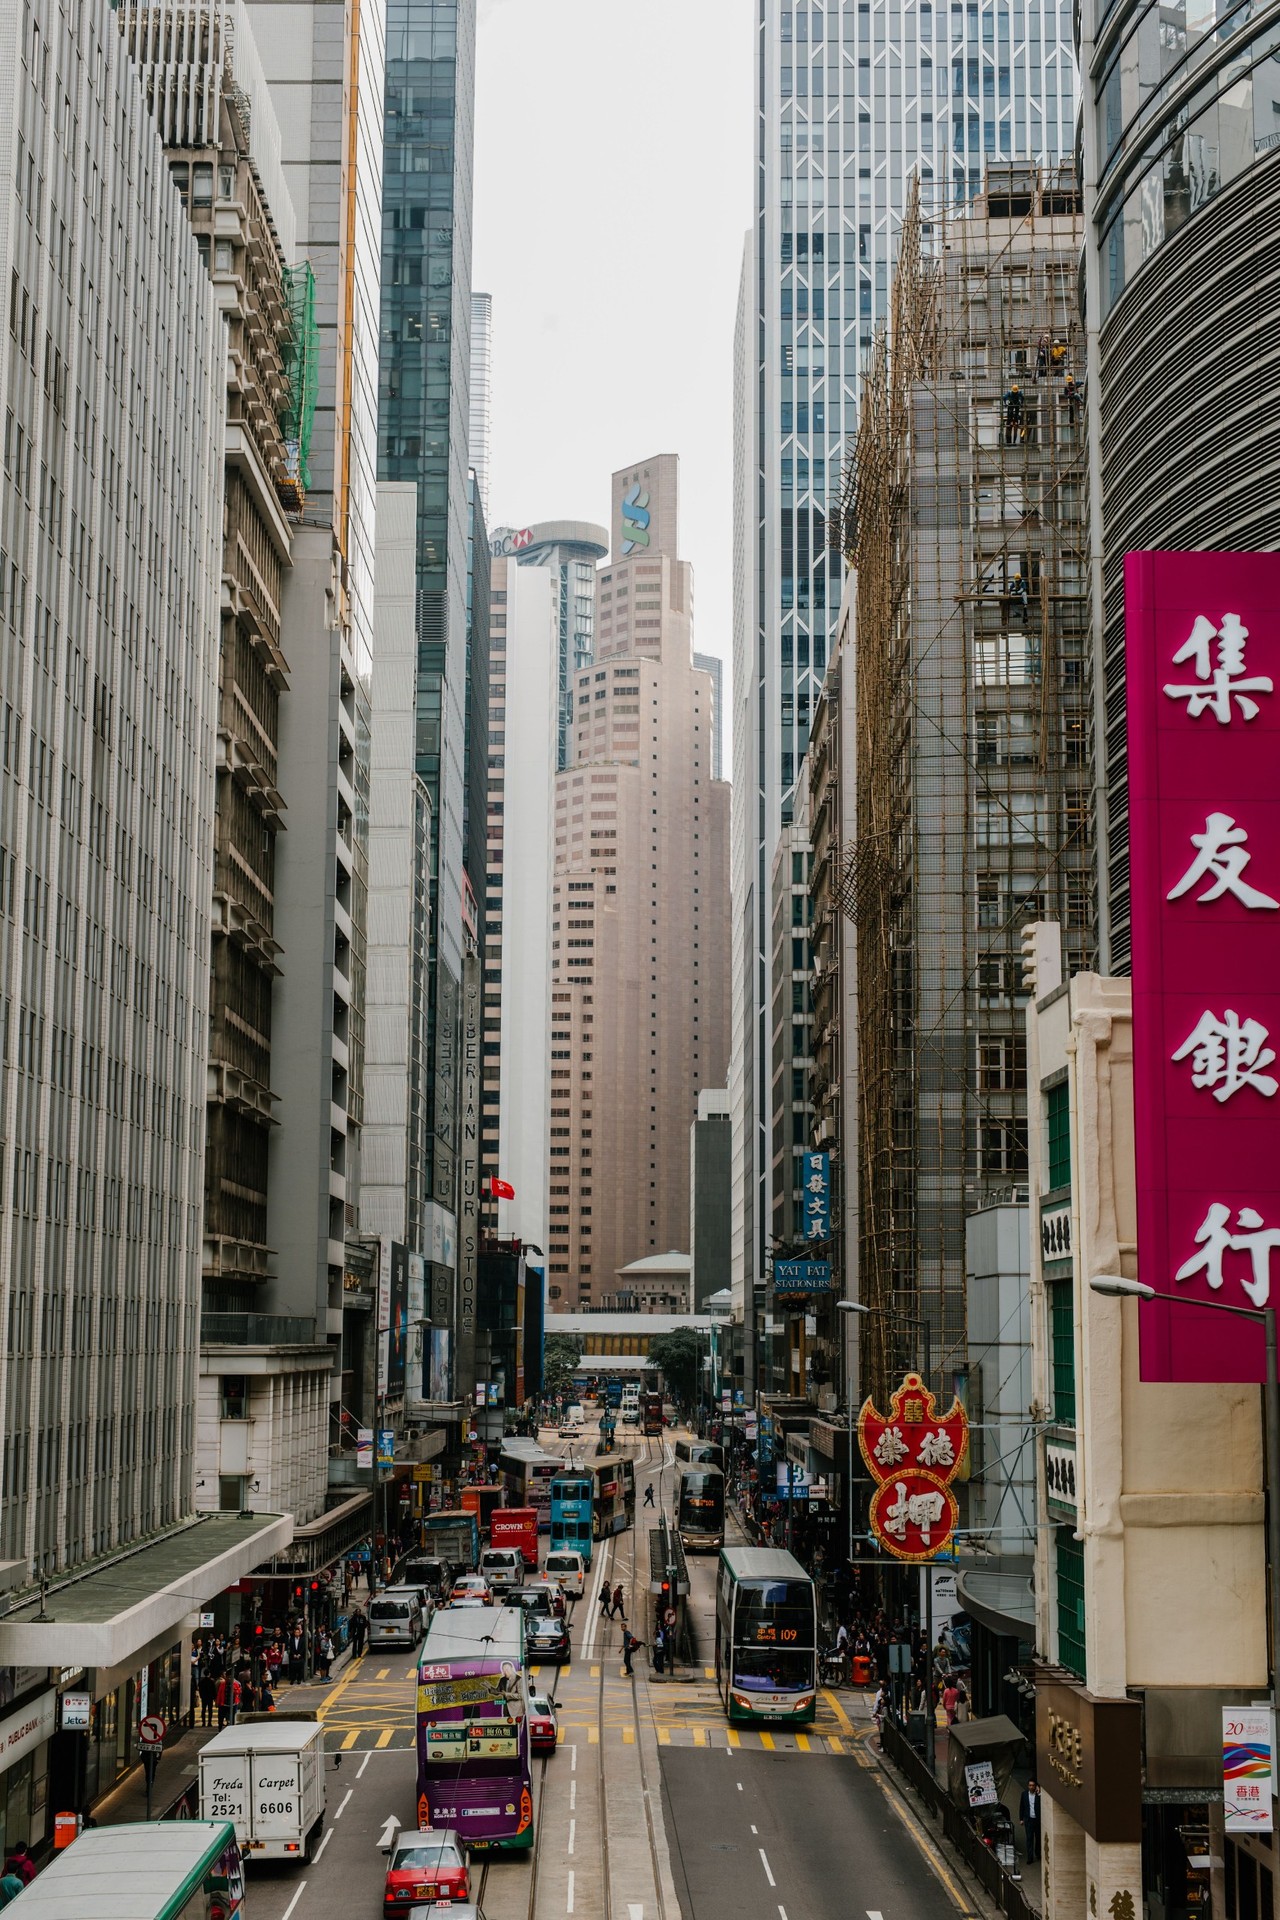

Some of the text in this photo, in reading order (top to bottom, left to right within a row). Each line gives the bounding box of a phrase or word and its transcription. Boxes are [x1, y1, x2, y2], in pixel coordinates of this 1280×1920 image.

[1162, 612, 1280, 1308] 集友銀行
[463, 983, 477, 1335] SIBERIAN FUR STORE
[806, 1154, 828, 1239] 日發文具
[778, 1265, 828, 1276] YAT FAT
[775, 1280, 830, 1288] STATIONERS
[883, 1481, 946, 1546] 押
[494, 1523, 523, 1531] CROWN
[780, 1629, 797, 1641] 109
[8, 1717, 38, 1747] PUBLIC BANK
[1225, 1722, 1244, 1735] 20
[213, 1777, 295, 1791] Freda Carpet
[212, 1793, 231, 1802] Tel:
[1236, 1785, 1260, 1797] 香港
[211, 1802, 293, 1816] 2521 6606
